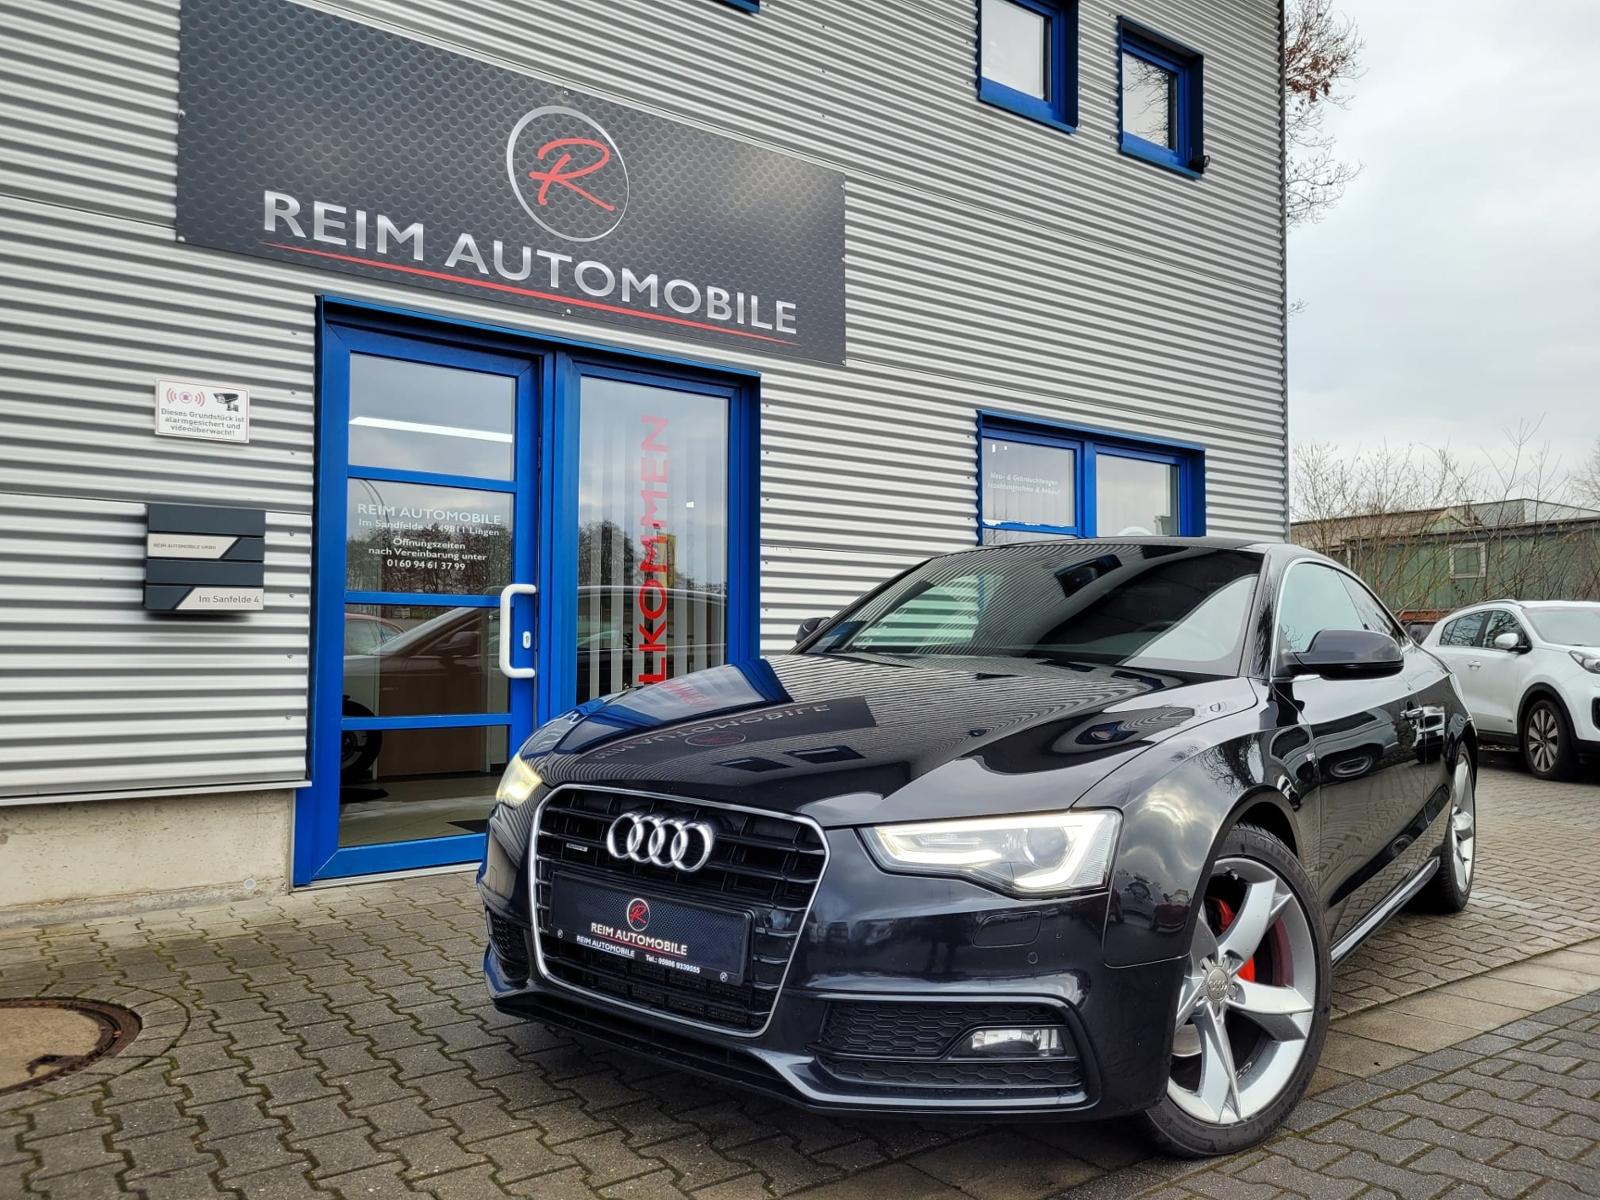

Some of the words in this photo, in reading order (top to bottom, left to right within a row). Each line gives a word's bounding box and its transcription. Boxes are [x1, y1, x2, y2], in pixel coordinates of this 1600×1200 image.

[528, 137, 617, 211] R
[263, 189, 425, 262] REIM
[444, 232, 798, 335] AUTOMOBILE
[161, 408, 187, 416] Dieses
[189, 411, 233, 422] Grundstück
[165, 416, 225, 428] alarmgesichert
[226, 422, 241, 430] und
[170, 425, 235, 437] videoüberwacht!
[357, 503, 395, 517] REIM
[400, 507, 502, 525] AUTOMOBILE
[359, 519, 372, 527] Im
[375, 519, 423, 530] Sandfelde
[438, 525, 465, 534] 49811
[469, 526, 500, 537] Lingen
[392, 536, 466, 550] Öffnungszeiten
[638, 415, 670, 683] LKOMMEN
[368, 547, 392, 556] nach
[394, 548, 459, 561] Vereinbarung
[461, 553, 488, 561] unter
[387, 558, 412, 568] 0160
[413, 560, 425, 569] 94
[427, 560, 438, 569] 61
[441, 561, 452, 570] 37
[454, 562, 466, 571] 99
[199, 595, 211, 603] Im
[212, 595, 252, 604] Sanfelde
[253, 595, 260, 604] 4
[576, 934, 592, 945] REIM
[592, 940, 635, 957] AUTOMOBILE
[591, 922, 614, 937] REIM
[615, 929, 688, 956] AUTOMOBILE
